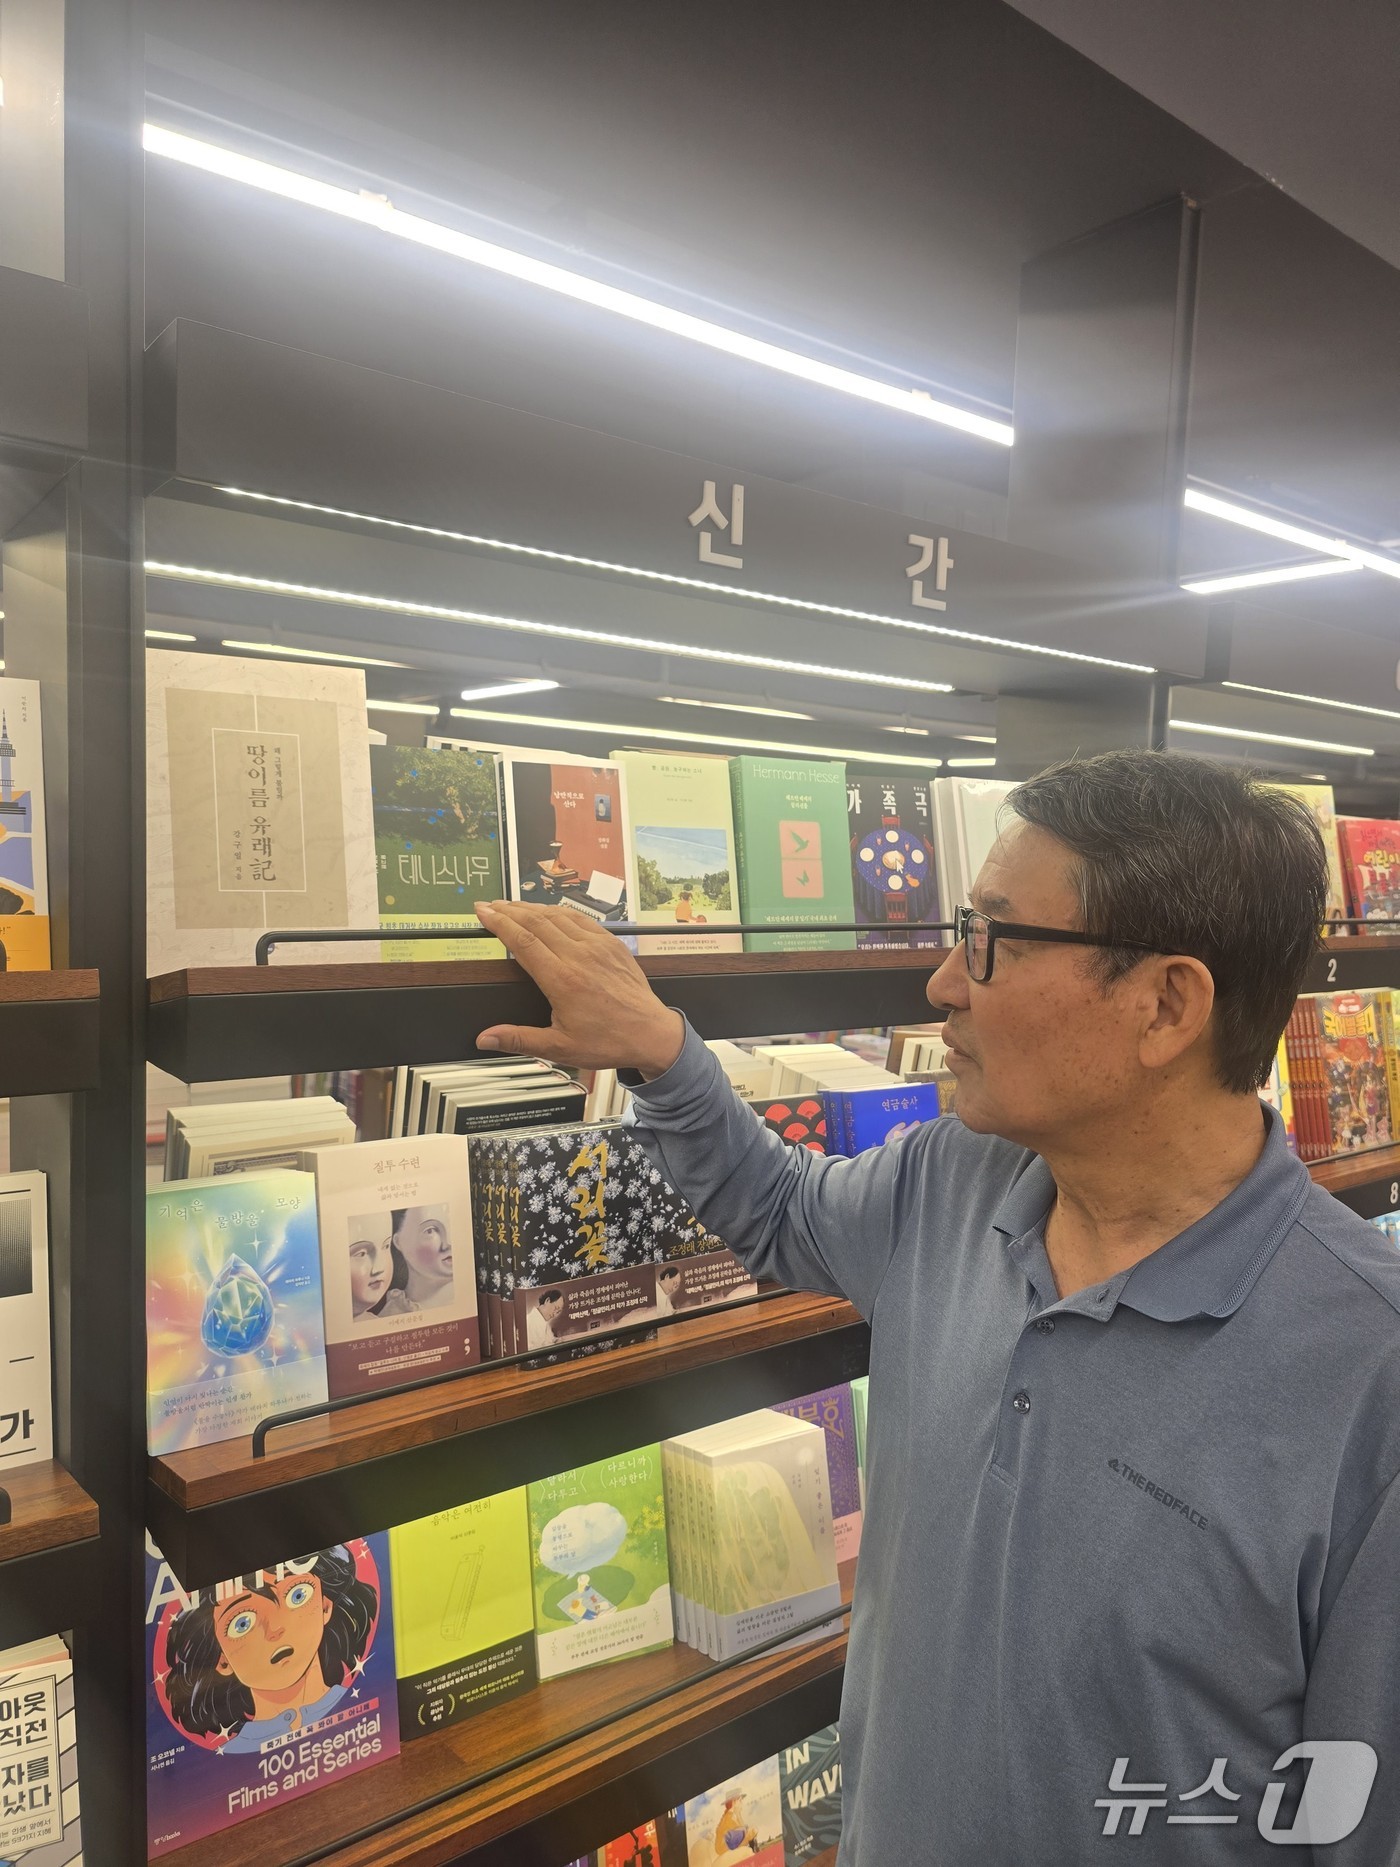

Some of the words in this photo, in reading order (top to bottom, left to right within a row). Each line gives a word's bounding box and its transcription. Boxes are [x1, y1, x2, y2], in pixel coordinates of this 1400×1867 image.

[688, 480, 744, 569] 신
[905, 534, 954, 611] 간
[246, 745, 270, 808] 땅이름
[753, 764, 807, 781] Hermann
[808, 769, 840, 784] Hesse
[398, 854, 490, 887] 테니스나무
[1327, 958, 1337, 982] 2
[881, 1096, 918, 1112] 연금술사
[373, 1160, 395, 1174] 질투
[398, 1156, 421, 1170] 수련
[568, 1140, 609, 1270] 서리꽃
[1390, 1182, 1399, 1204] 8
[159, 1199, 204, 1221] 기억은
[215, 1211, 259, 1229] 물방울
[275, 1197, 301, 1210] 모양
[670, 1240, 695, 1256] 조정래
[697, 1236, 727, 1252] 장편소
[608, 1456, 647, 1473] 다르니까
[610, 1470, 647, 1488] 사랑한다
[548, 1487, 578, 1501] 다투고
[464, 1499, 491, 1515] 여전히
[258, 1749, 295, 1779] 100
[299, 1713, 381, 1764] Essential
[266, 1737, 282, 1749] 죽기
[286, 1729, 302, 1742] 전에
[306, 1724, 314, 1733] 꼭
[786, 1742, 810, 1775] IN
[2, 1756, 50, 1789] 자를
[228, 1780, 279, 1814] Films
[282, 1758, 319, 1791] and
[323, 1737, 382, 1773] Series
[3, 1784, 52, 1818] 났다
